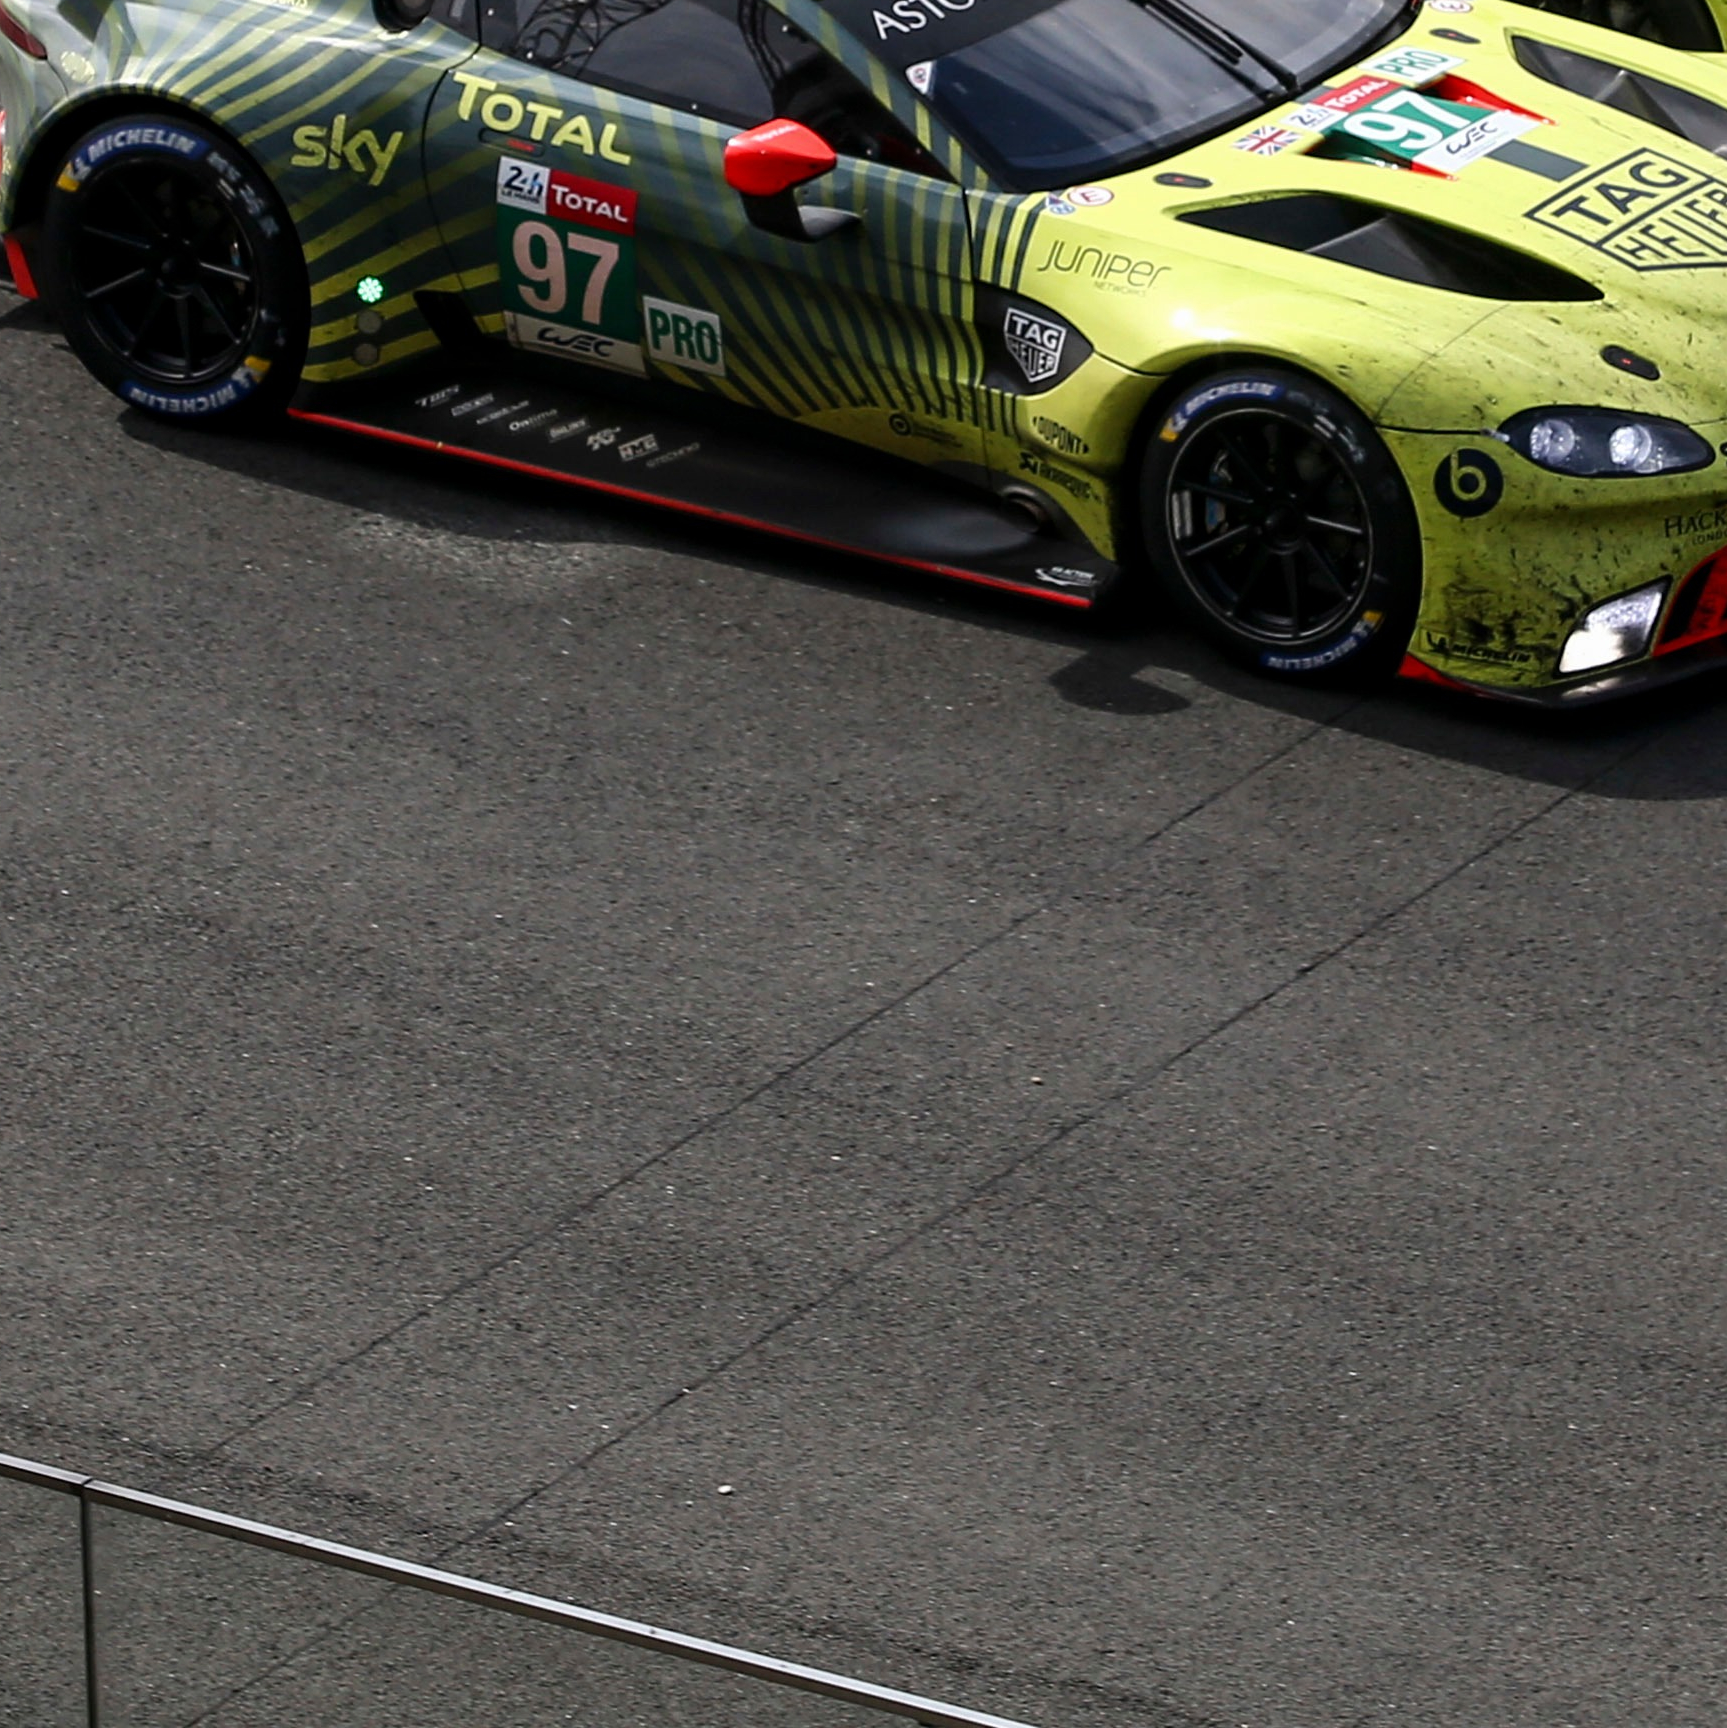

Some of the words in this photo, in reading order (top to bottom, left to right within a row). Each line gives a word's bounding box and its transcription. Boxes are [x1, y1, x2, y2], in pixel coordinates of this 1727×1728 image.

[1376, 51, 1449, 79] PRO
[1324, 79, 1391, 110] TOTAL
[453, 71, 632, 166] TOTAL
[1343, 90, 1473, 150] 97
[86, 128, 197, 164] MICHELIN
[291, 114, 404, 186] sky
[1445, 121, 1500, 156] WEC
[503, 165, 544, 198] 24h
[1552, 159, 1690, 227] TAG
[551, 183, 629, 223] TOTAL
[512, 220, 620, 326] 97
[537, 327, 615, 358] WEC
[648, 307, 721, 366] PRO
[1012, 315, 1059, 351] TAG
[1011, 342, 1058, 377] HEUER
[1184, 379, 1279, 415] MICHELIN
